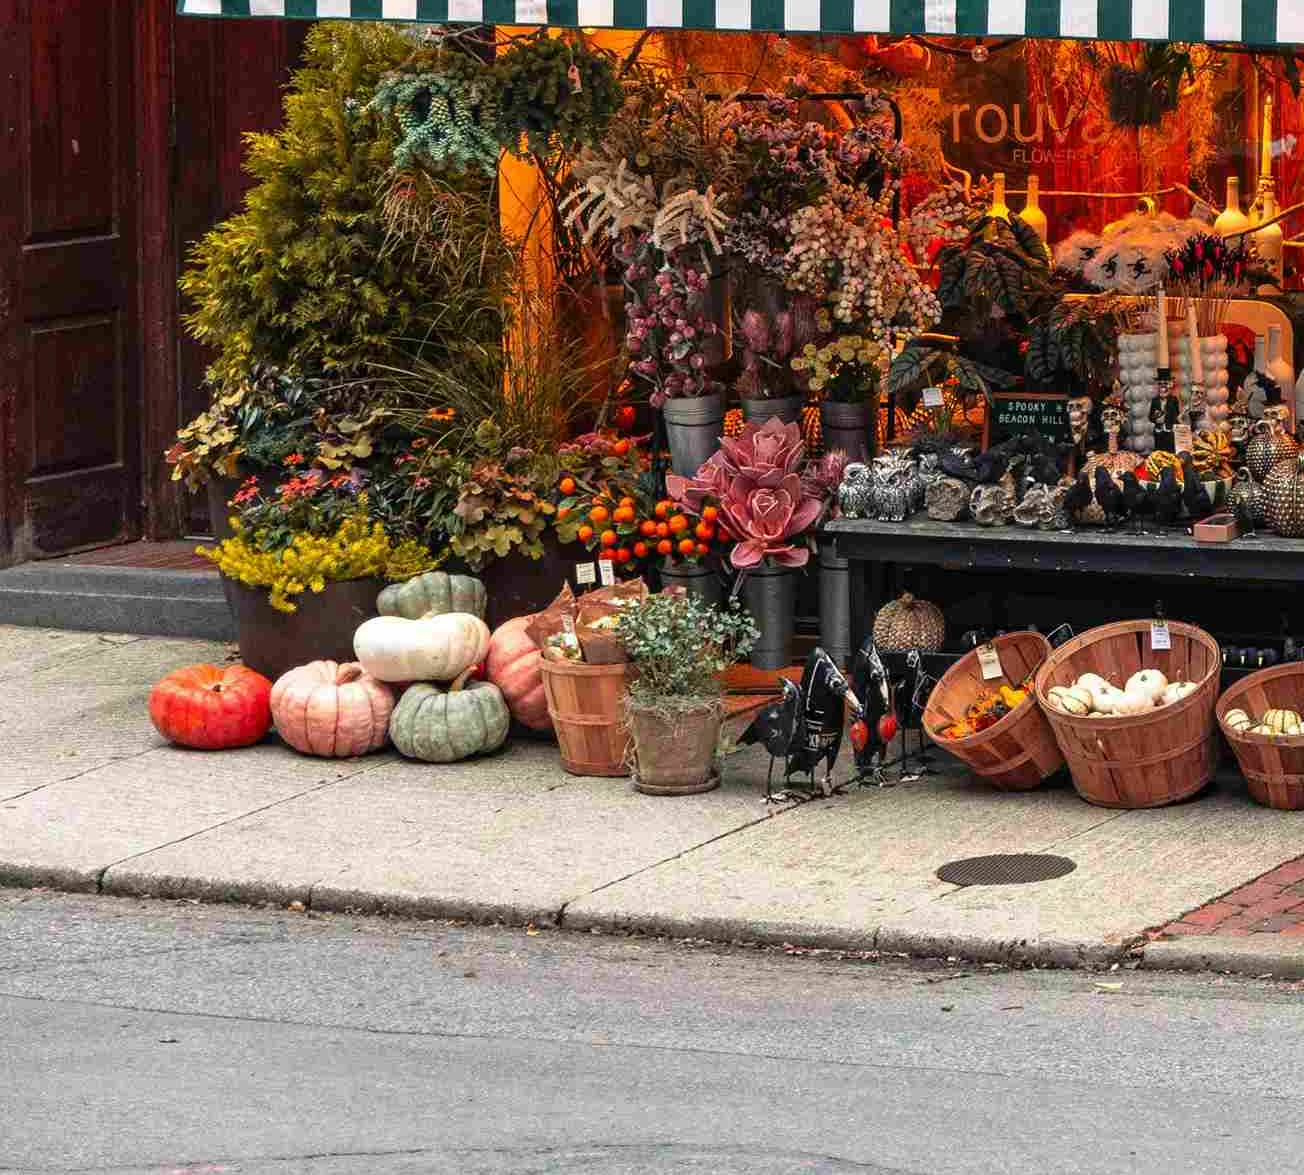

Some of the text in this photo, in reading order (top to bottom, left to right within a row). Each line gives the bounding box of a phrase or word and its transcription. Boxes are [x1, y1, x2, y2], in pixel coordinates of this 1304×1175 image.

[1007, 401, 1047, 412] SPOOKY
[998, 414, 1064, 425] BEACON HILL
